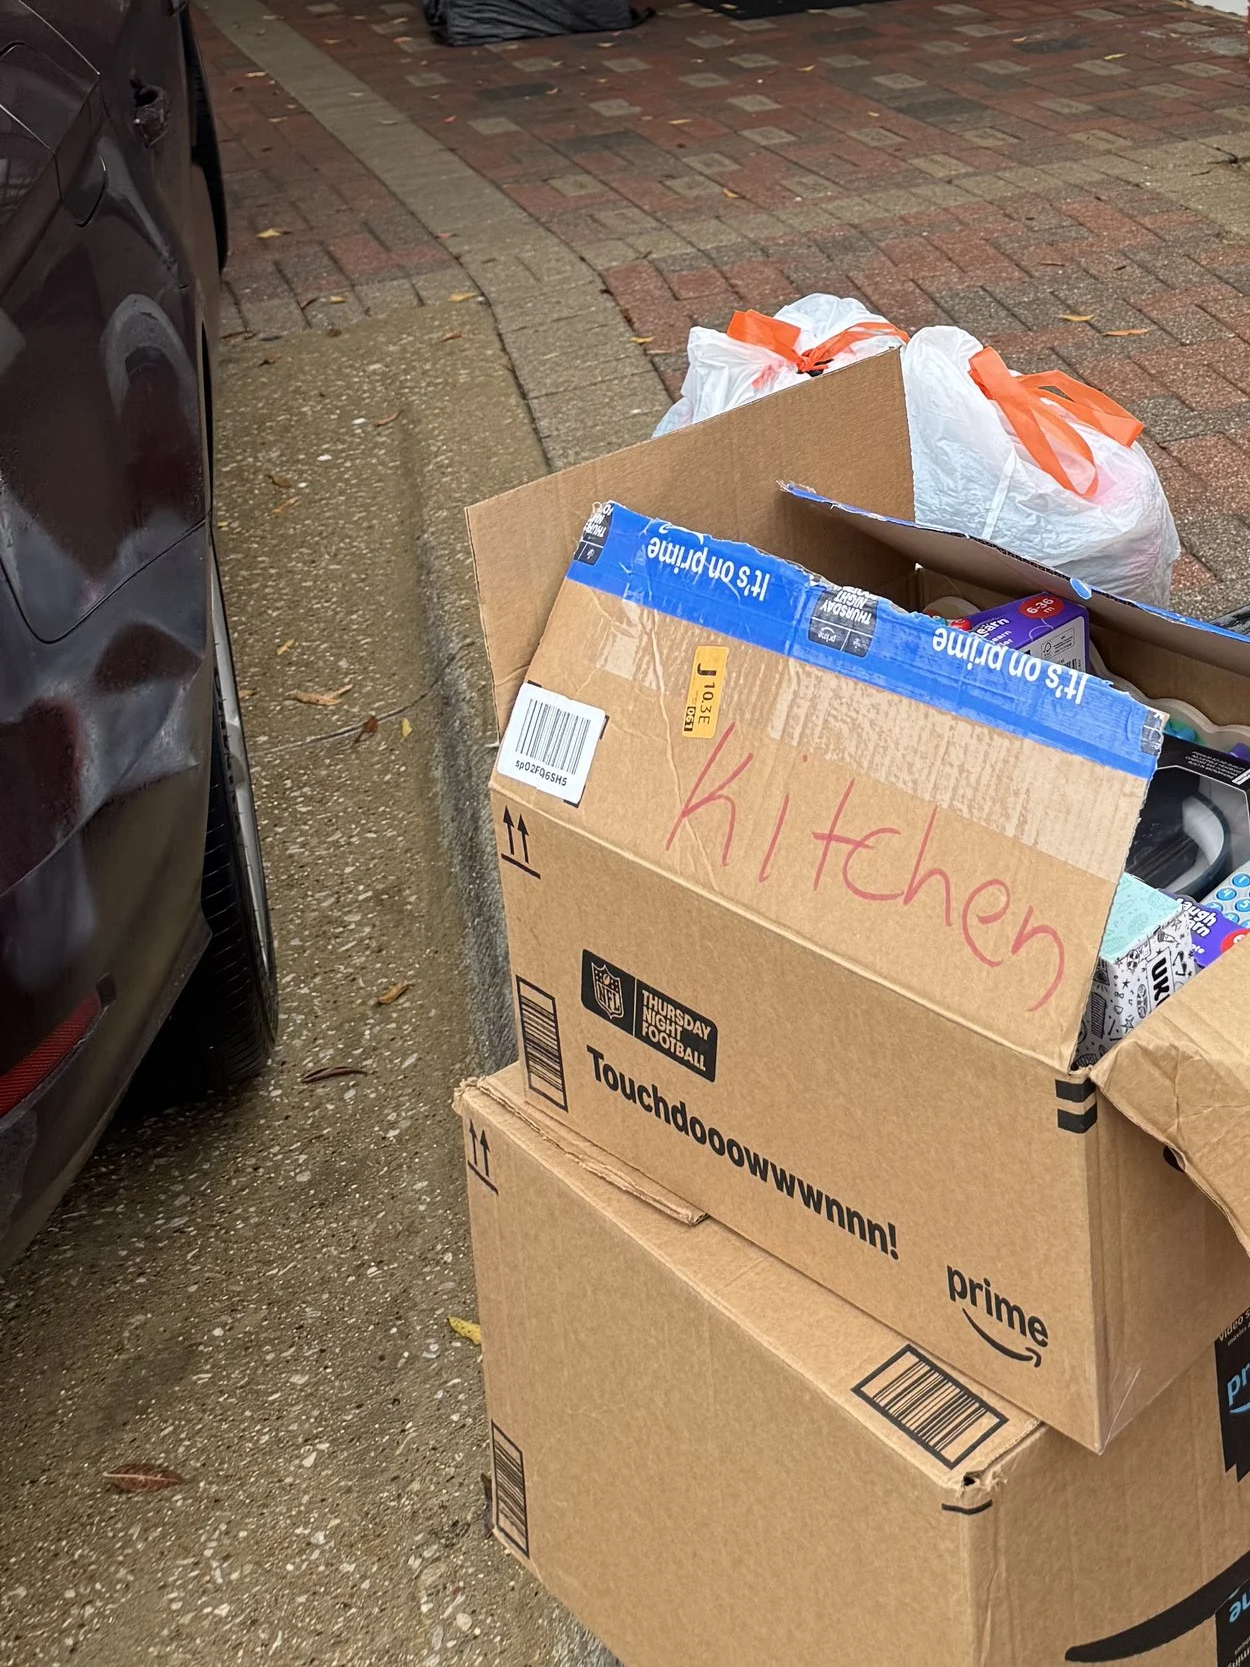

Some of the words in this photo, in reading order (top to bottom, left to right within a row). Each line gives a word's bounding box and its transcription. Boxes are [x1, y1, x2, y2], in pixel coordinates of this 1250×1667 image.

[647, 537, 708, 580] prime
[708, 557, 735, 582] on
[736, 565, 770, 601] It's
[820, 599, 872, 625] THURSDAY
[834, 590, 868, 610] NIGHT
[1026, 597, 1055, 614] 6-36
[932, 627, 1008, 671] prime
[697, 663, 717, 676] J
[1008, 651, 1042, 682] on
[1045, 664, 1089, 705] It's
[697, 681, 716, 725] 10.3E
[684, 706, 696, 732] 061
[1222, 888, 1233, 897] 4
[1238, 875, 1245, 884] 1
[1240, 900, 1248, 909] 5
[596, 983, 621, 1012] NFL
[641, 989, 712, 1041] THURSDAY
[642, 1007, 683, 1041] NIGHT
[642, 1021, 706, 1072] FOOTBALL
[585, 1044, 900, 1261] Touchdooowwwnnn!
[946, 1264, 1049, 1349] prime
